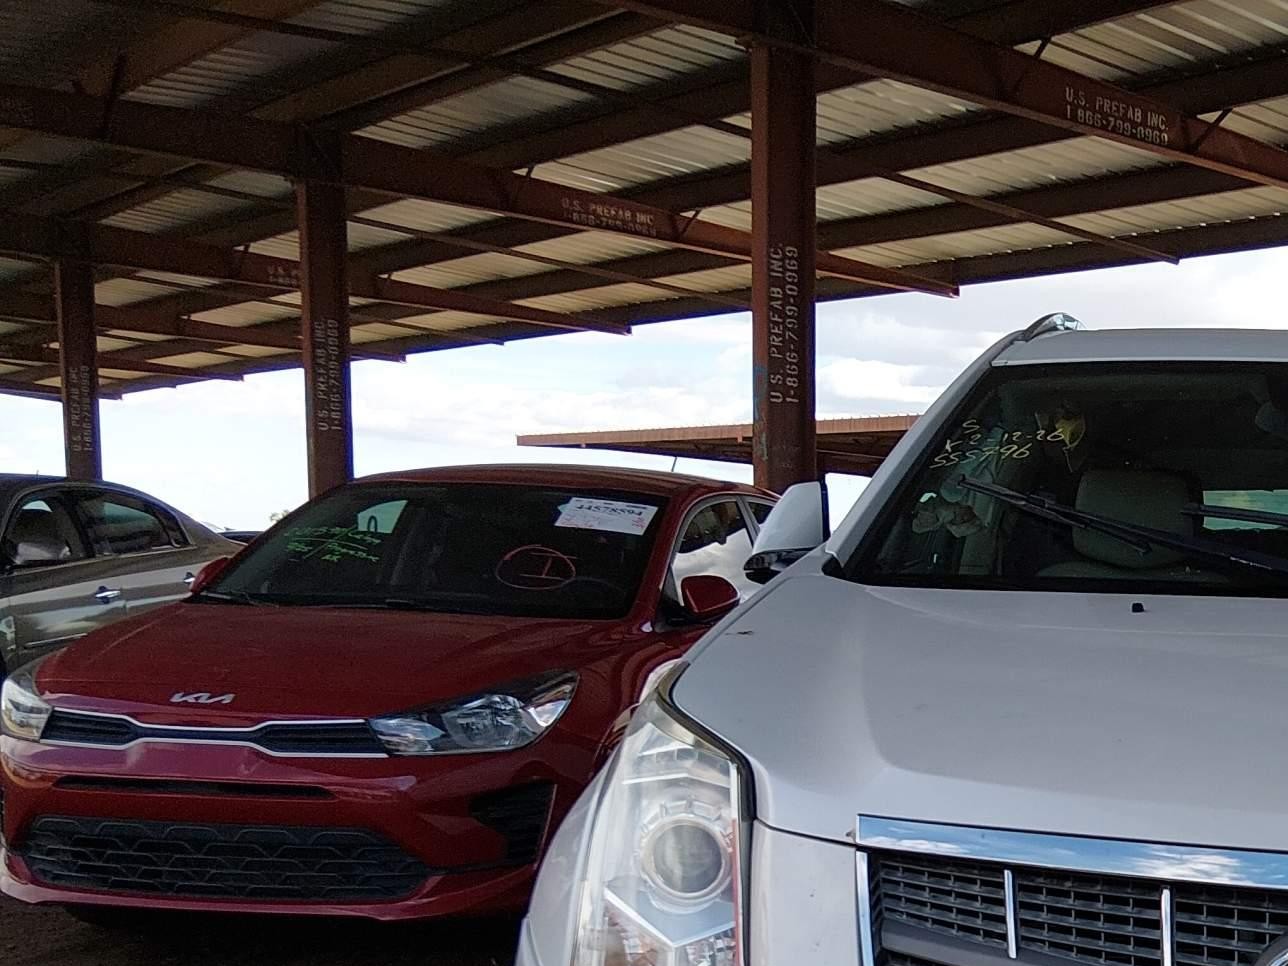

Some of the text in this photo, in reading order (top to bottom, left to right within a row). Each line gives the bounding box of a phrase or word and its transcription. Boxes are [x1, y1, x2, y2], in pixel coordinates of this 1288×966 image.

[1065, 87, 1169, 131] U.S. PREFAB INC.
[770, 243, 784, 277] INC.
[770, 287, 784, 358] PREFAB
[785, 246, 799, 403] 1-866-799-0969
[315, 348, 328, 400] PREFAB
